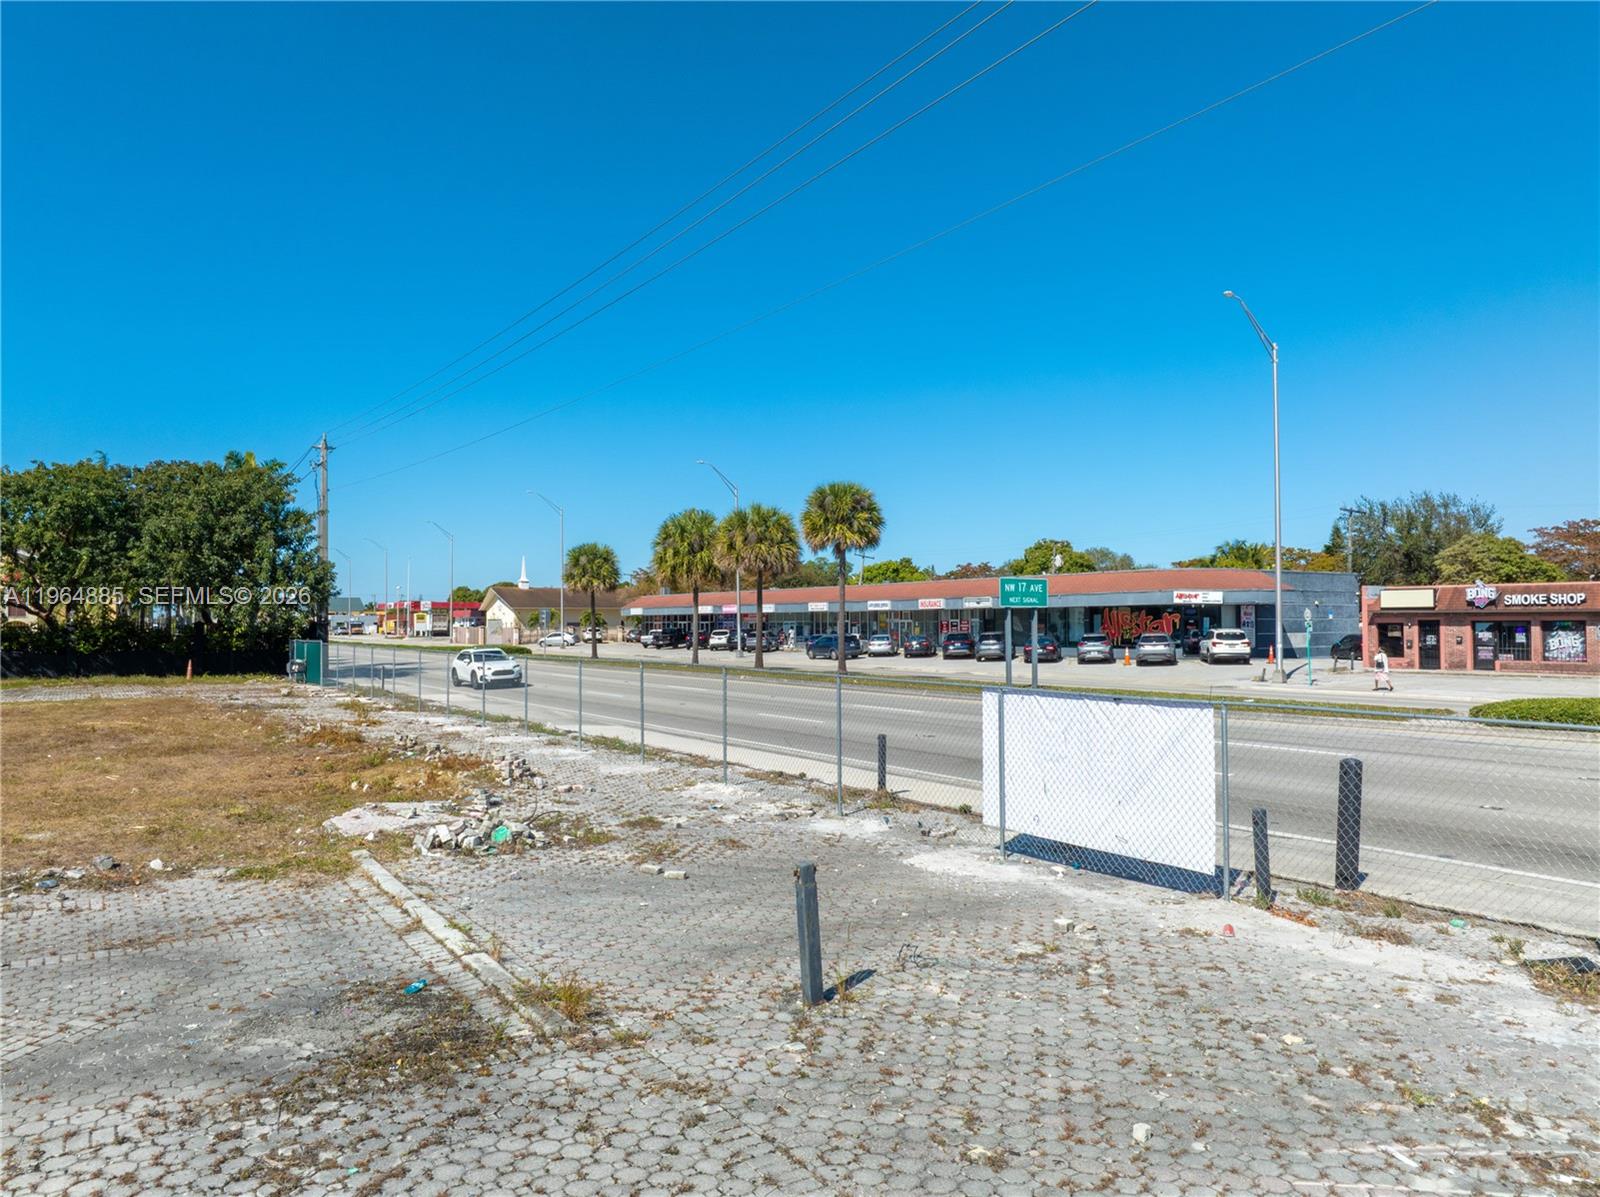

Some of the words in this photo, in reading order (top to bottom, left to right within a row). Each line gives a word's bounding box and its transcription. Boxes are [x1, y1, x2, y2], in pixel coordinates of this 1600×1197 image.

[1004, 583, 1015, 592] NW
[1018, 582, 1027, 593] 17
[1030, 584, 1043, 593] AVE
[1465, 587, 1497, 600] BONG
[1504, 593, 1548, 605] SMOKE
[1549, 592, 1586, 605] SHOP
[1549, 634, 1583, 650] BONG
